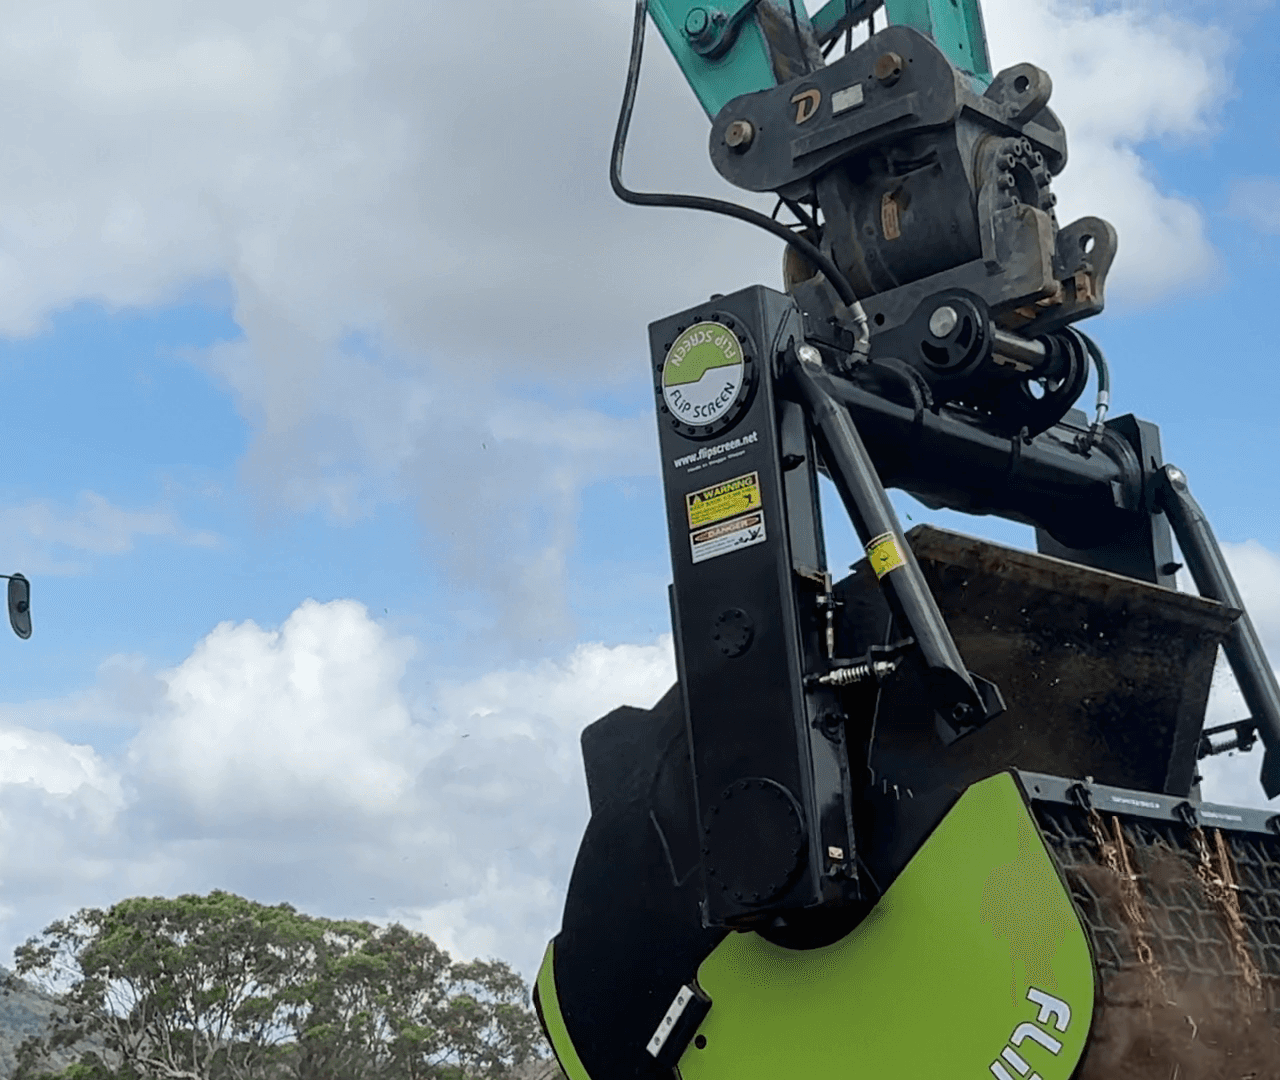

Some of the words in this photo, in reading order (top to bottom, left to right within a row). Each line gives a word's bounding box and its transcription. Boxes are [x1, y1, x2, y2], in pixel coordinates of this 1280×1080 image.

[671, 330, 714, 366] SCREEN
[693, 382, 735, 418] SCREEN
[674, 431, 758, 468] www.flipscreen.net
[702, 477, 753, 501] WARNING
